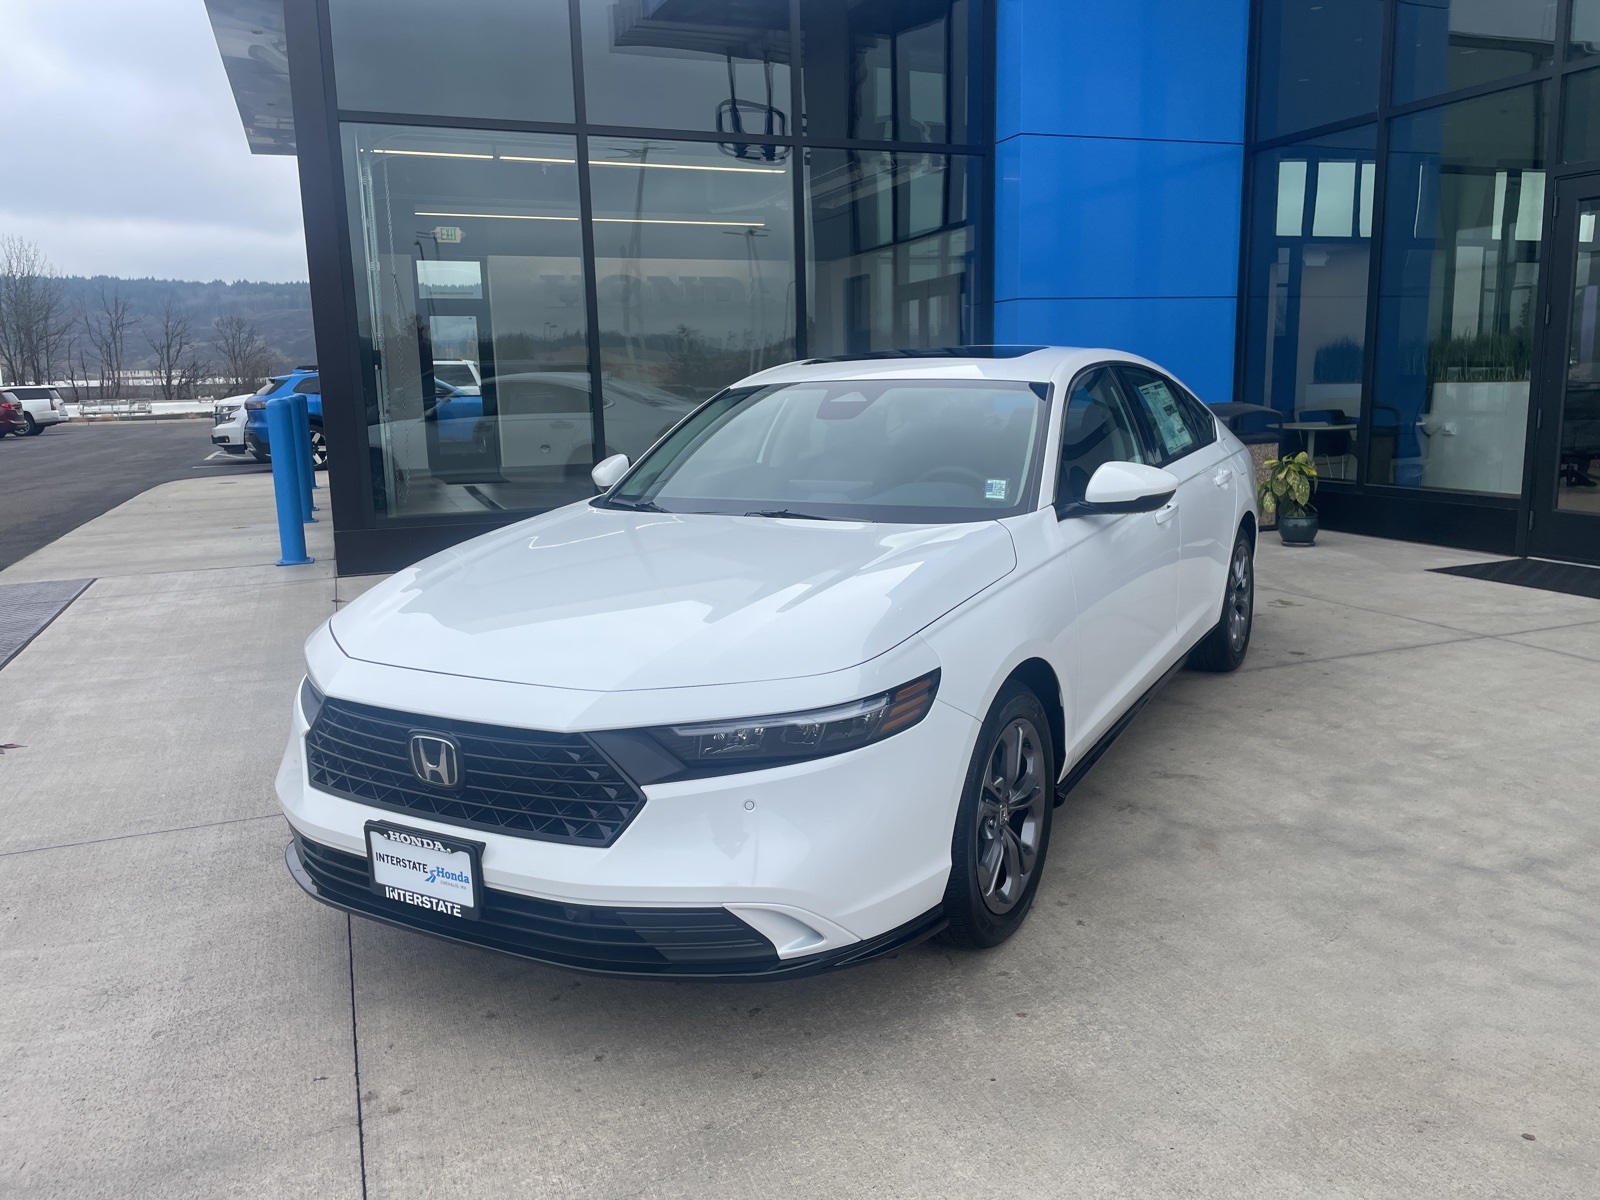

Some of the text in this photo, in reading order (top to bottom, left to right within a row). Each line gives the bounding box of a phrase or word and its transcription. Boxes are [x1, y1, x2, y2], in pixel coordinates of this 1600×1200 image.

[440, 227, 457, 241] EXIT
[388, 830, 445, 853] HONDA
[375, 851, 470, 884] INTERSTATE Honda
[385, 886, 462, 918] INTERSTATE
